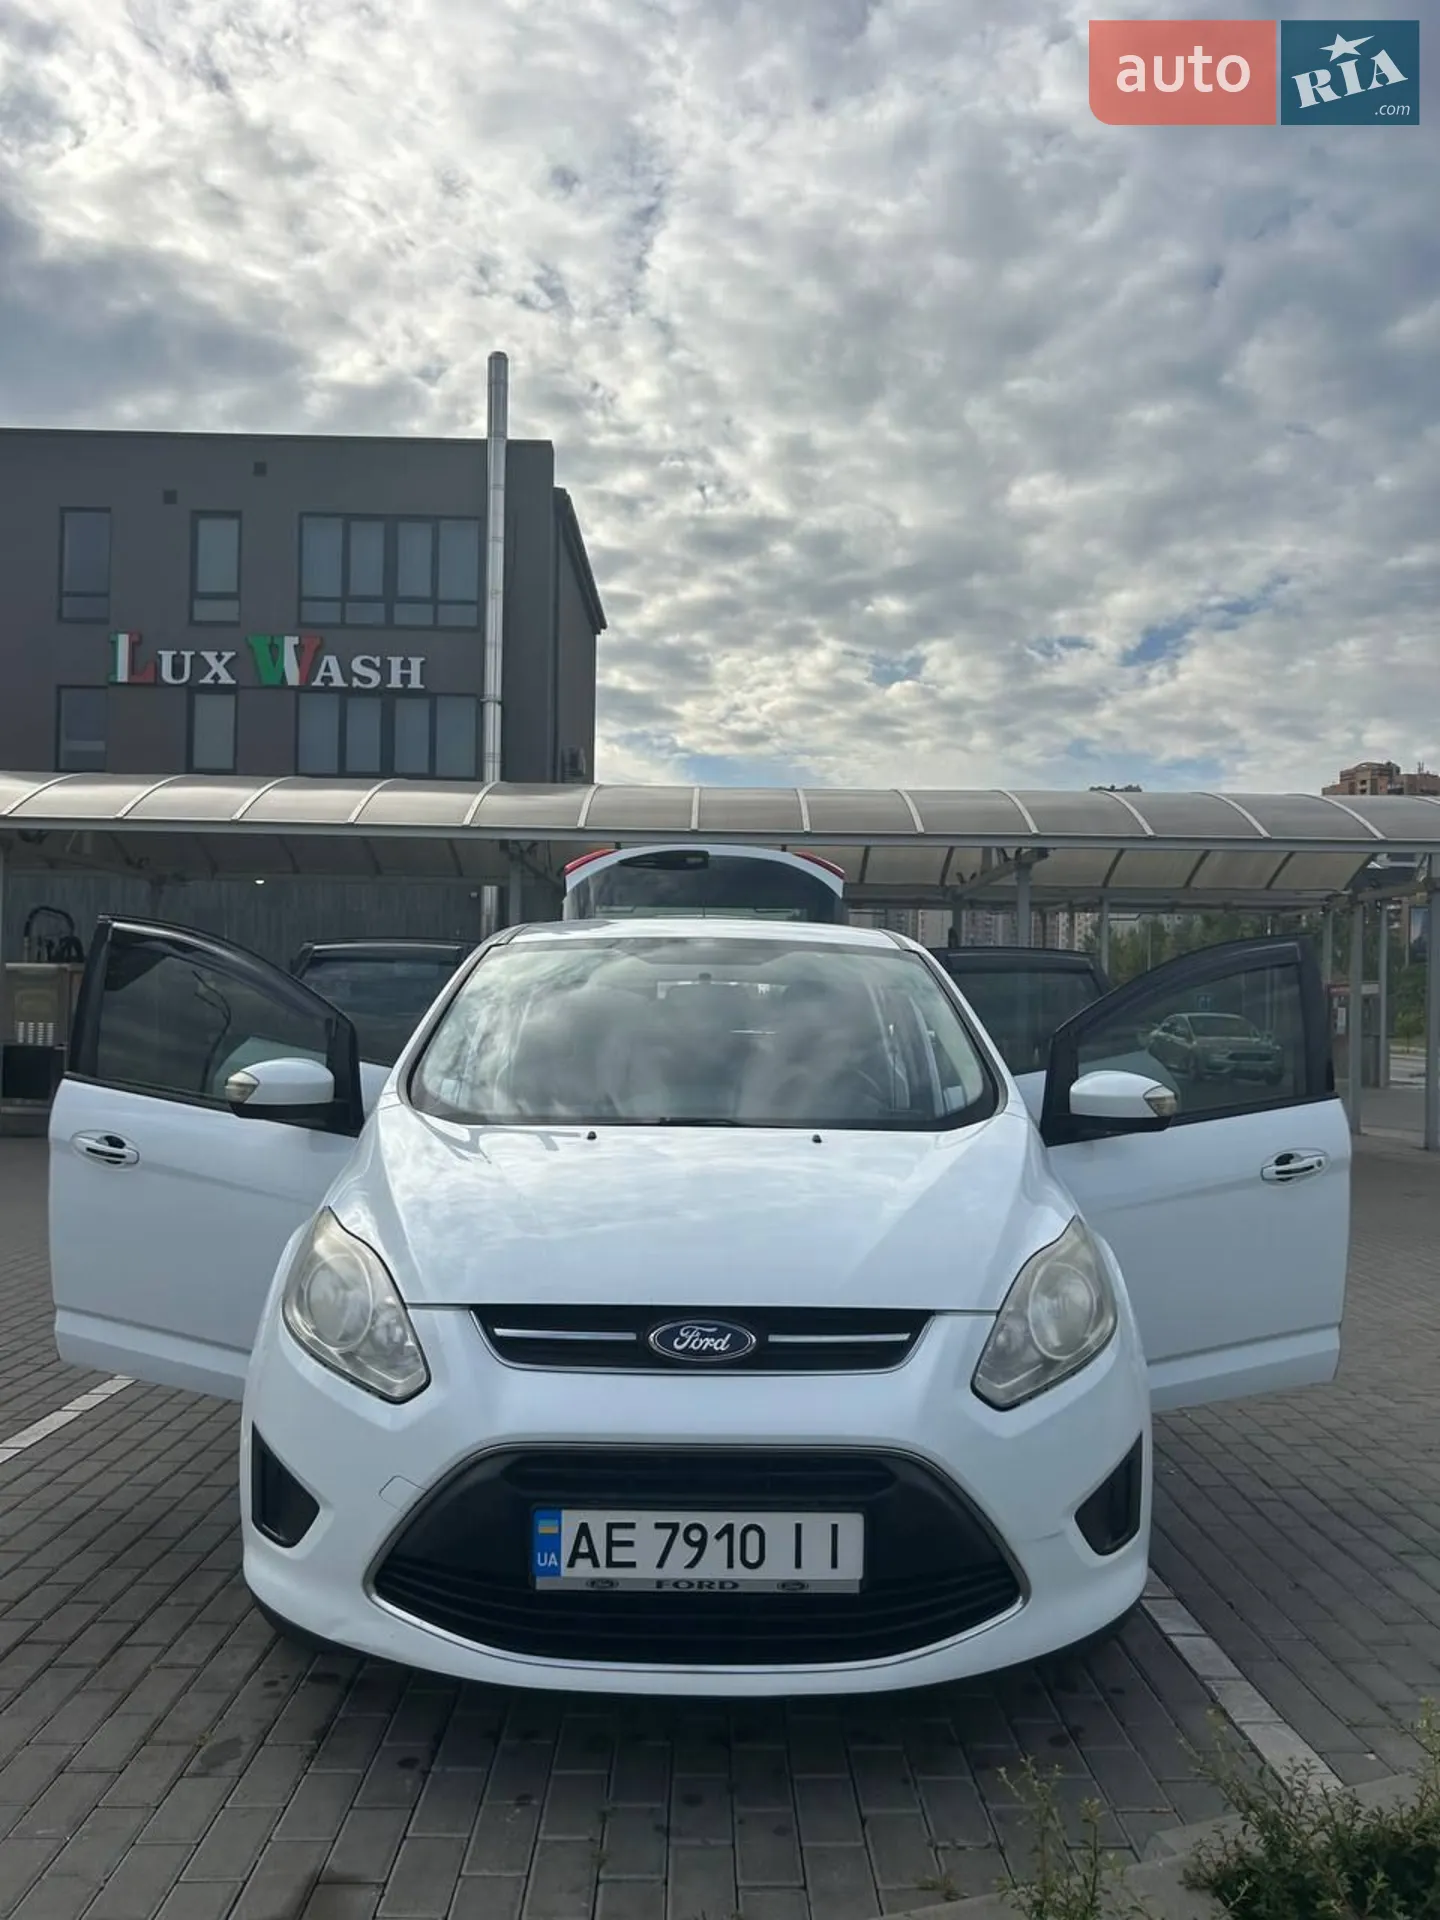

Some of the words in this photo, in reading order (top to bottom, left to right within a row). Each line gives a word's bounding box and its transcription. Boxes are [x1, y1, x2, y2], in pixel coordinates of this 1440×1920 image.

[673, 1325, 732, 1351] Ford
[566, 1522, 637, 1569] AE
[654, 1522, 766, 1570] 7910
[537, 1552, 558, 1567] UA
[655, 1579, 740, 1591] FORD
